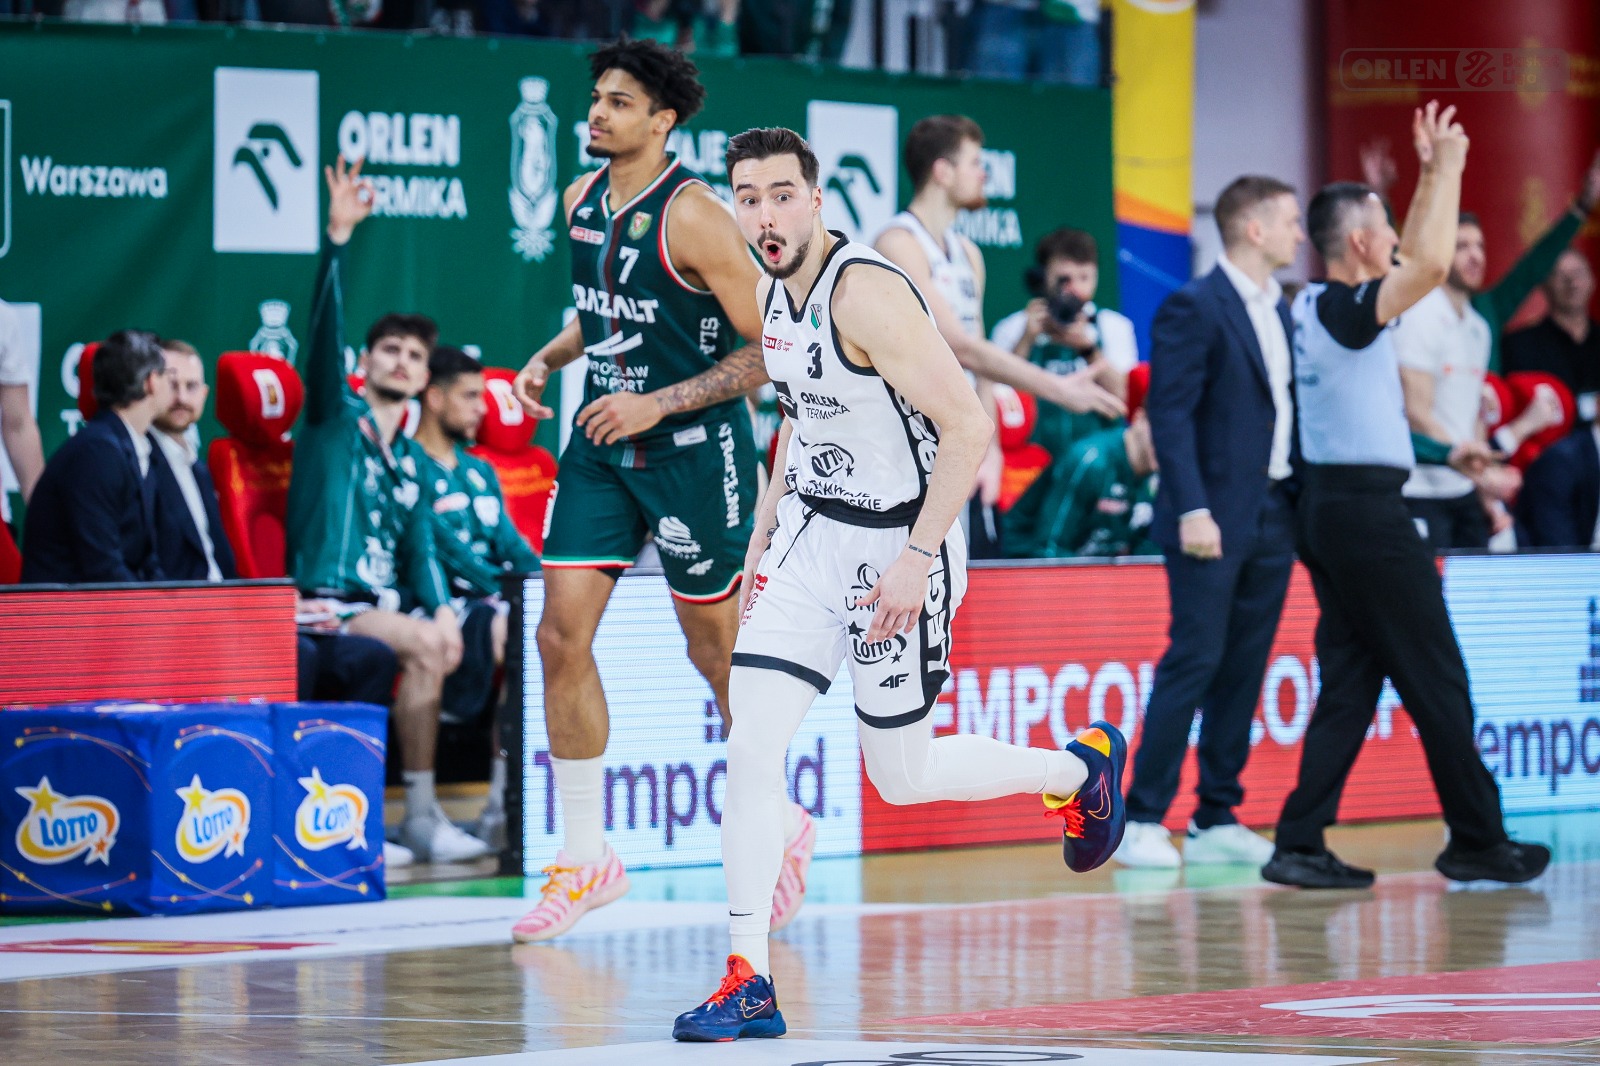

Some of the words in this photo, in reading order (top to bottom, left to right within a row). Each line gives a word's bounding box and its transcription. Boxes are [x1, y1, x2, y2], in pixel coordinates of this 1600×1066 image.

[338, 109, 460, 167] ORLEN
[20, 154, 168, 199] Warszawa
[354, 174, 468, 219] RMIKA
[618, 246, 640, 285] 7
[806, 342, 823, 380] 3
[800, 391, 841, 408] ORLEN
[805, 405, 851, 420] TERMIKA
[925, 548, 948, 674] LEGI
[853, 637, 892, 659] LOTTO
[879, 672, 910, 689] 4F
[39, 812, 98, 847] LOTTO
[193, 806, 234, 843] LOTTO
